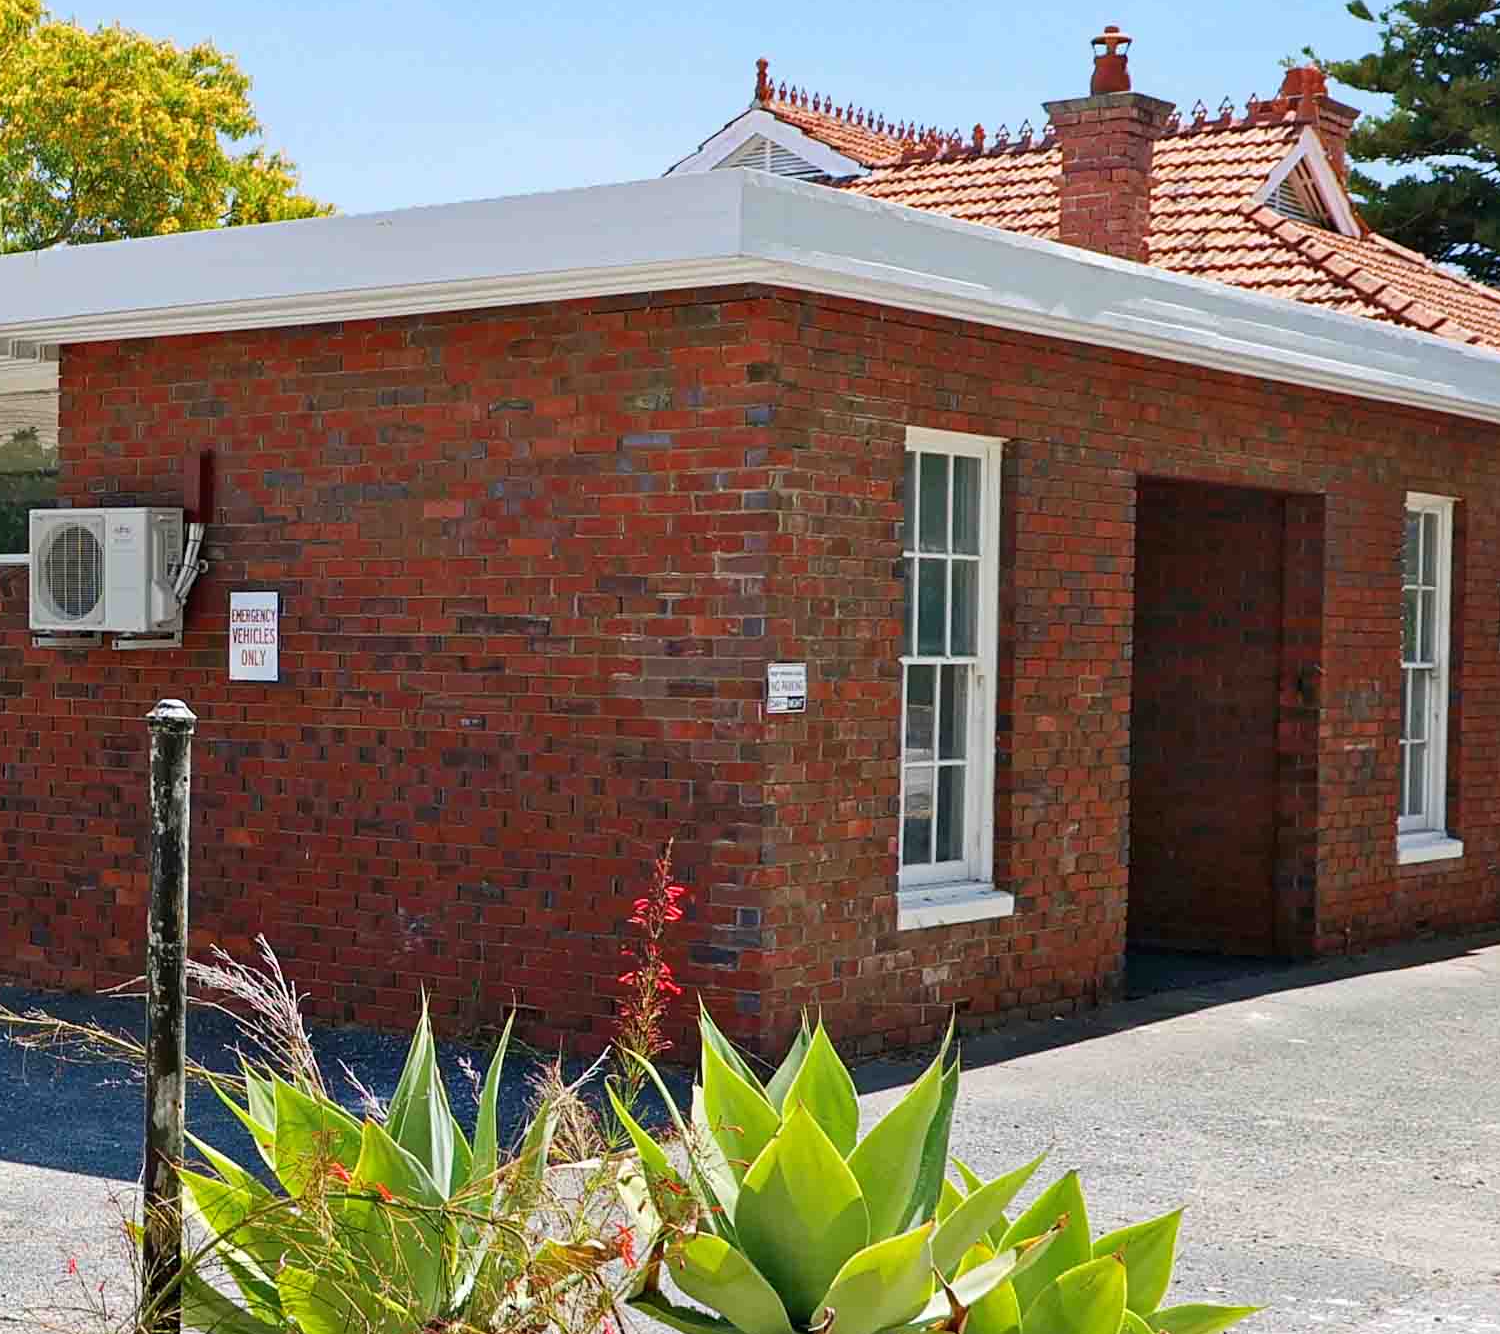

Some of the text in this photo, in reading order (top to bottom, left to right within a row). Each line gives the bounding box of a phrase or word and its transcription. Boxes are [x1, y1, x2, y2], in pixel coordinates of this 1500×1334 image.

[231, 609, 276, 623] EMERGENCY
[231, 627, 276, 644] VEHICLES
[241, 649, 266, 666] ONLY
